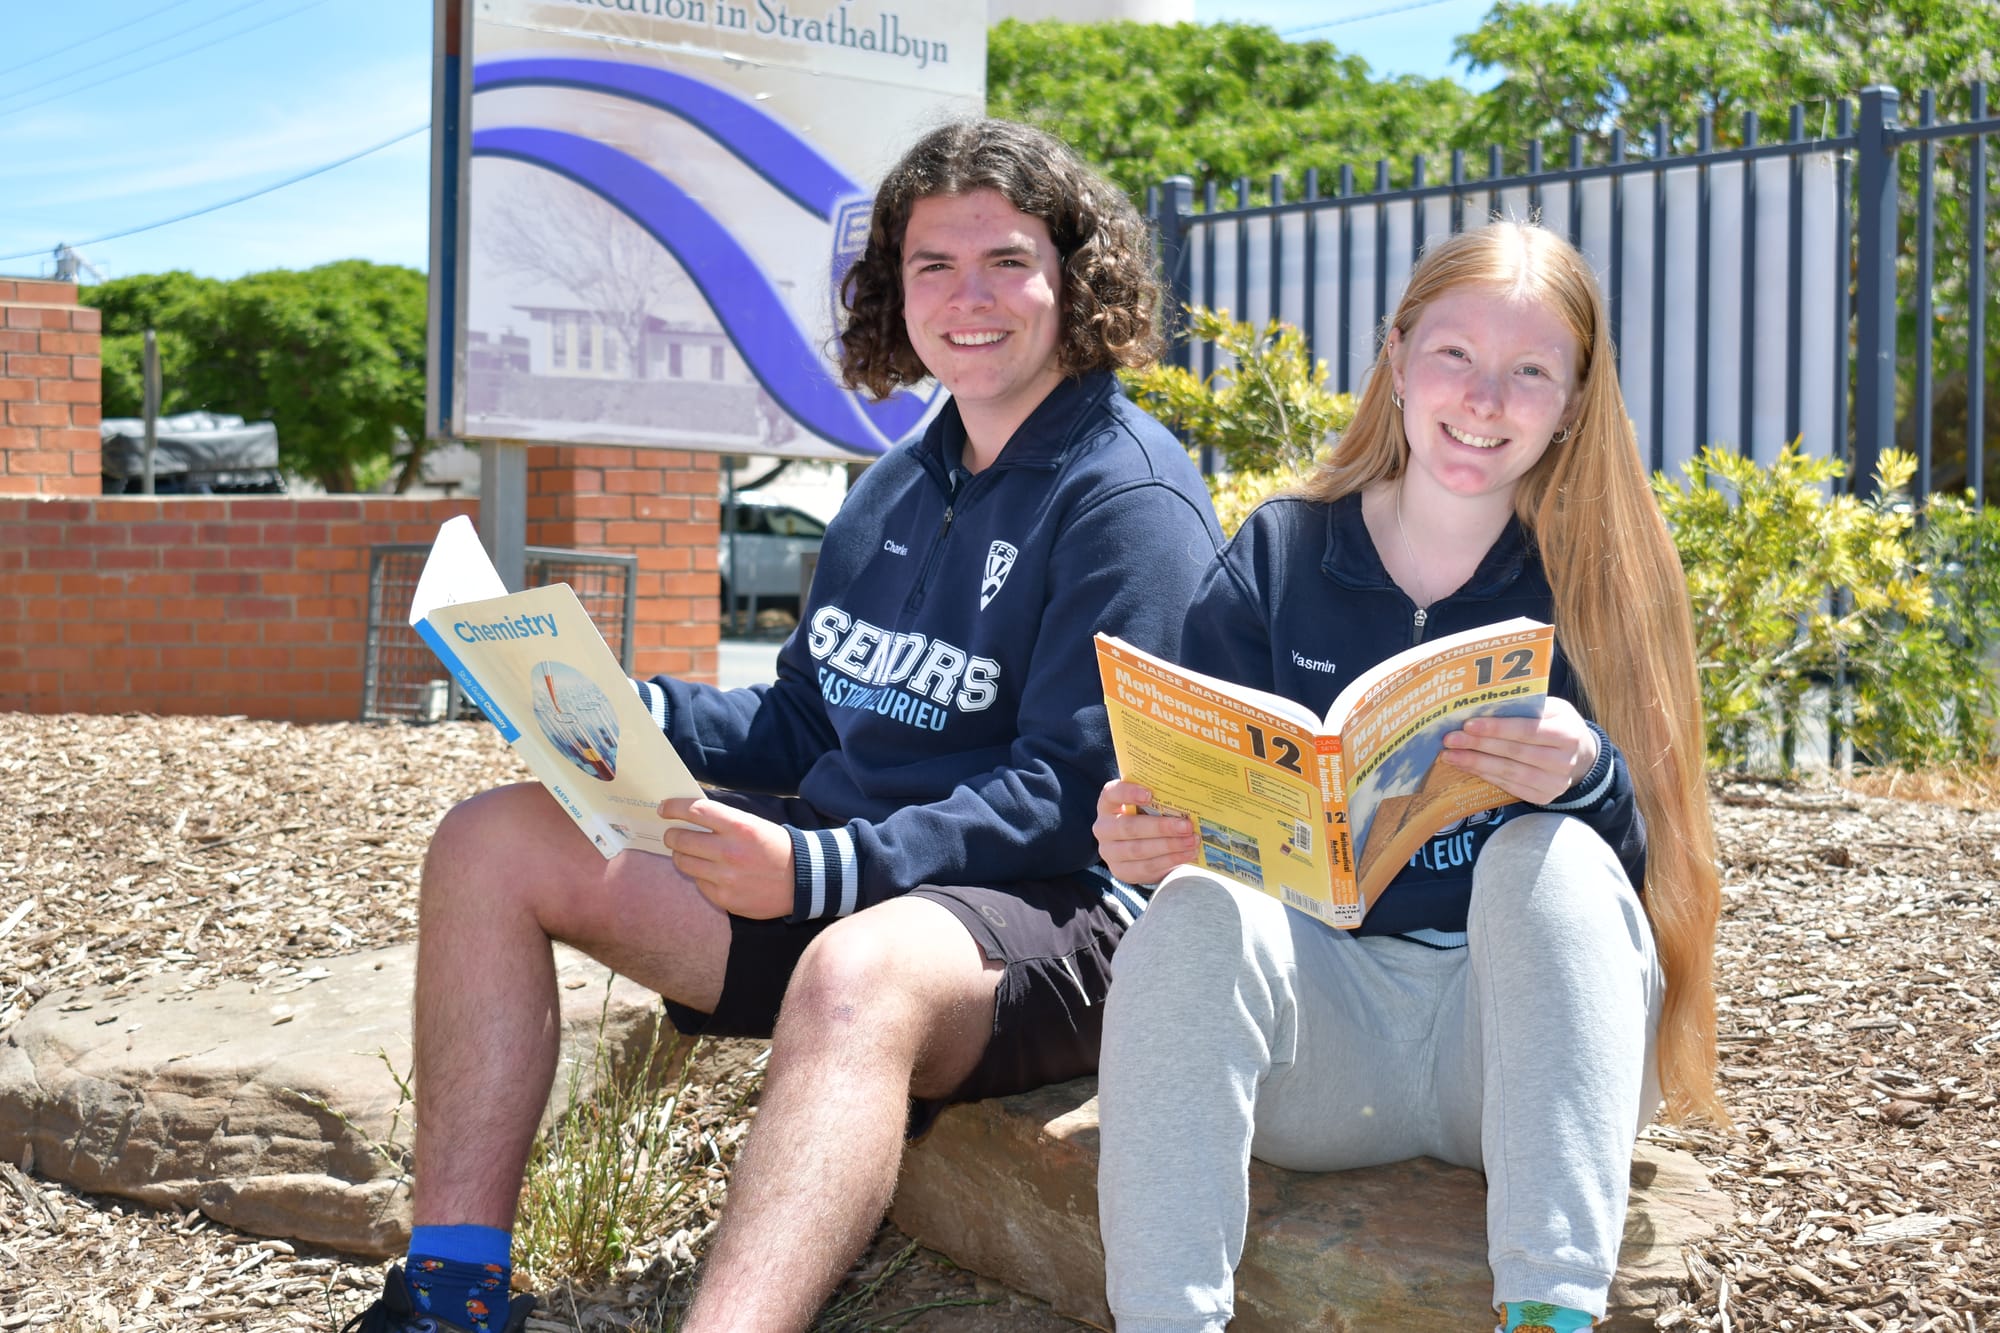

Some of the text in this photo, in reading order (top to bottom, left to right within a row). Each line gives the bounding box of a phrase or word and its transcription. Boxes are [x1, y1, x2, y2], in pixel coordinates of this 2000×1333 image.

[716, 0, 746, 29] in
[755, 0, 949, 69] Strathalbyn
[989, 542, 1016, 562] EFS
[453, 613, 559, 643] Chemistry
[1291, 649, 1336, 674] Yasmin
[1372, 631, 1537, 707] HAESE MATHEMATICS
[1474, 648, 1536, 686] 12
[483, 701, 508, 729] Chemistry
[1114, 667, 1240, 734] Mathematics
[1116, 685, 1144, 708] for
[1150, 702, 1241, 750] Australia
[1137, 661, 1299, 735] HAESE MATHEMATICS
[1352, 664, 1467, 751] Mathematics
[1245, 723, 1303, 775] 12
[1353, 680, 1465, 769] for Australia
[1355, 685, 1530, 786] Mathematical Methods
[1317, 755, 1333, 802] for Australia
[1329, 755, 1346, 802] Mathematics
[1325, 811, 1347, 823] 12
[1340, 832, 1352, 873] Mathematical
